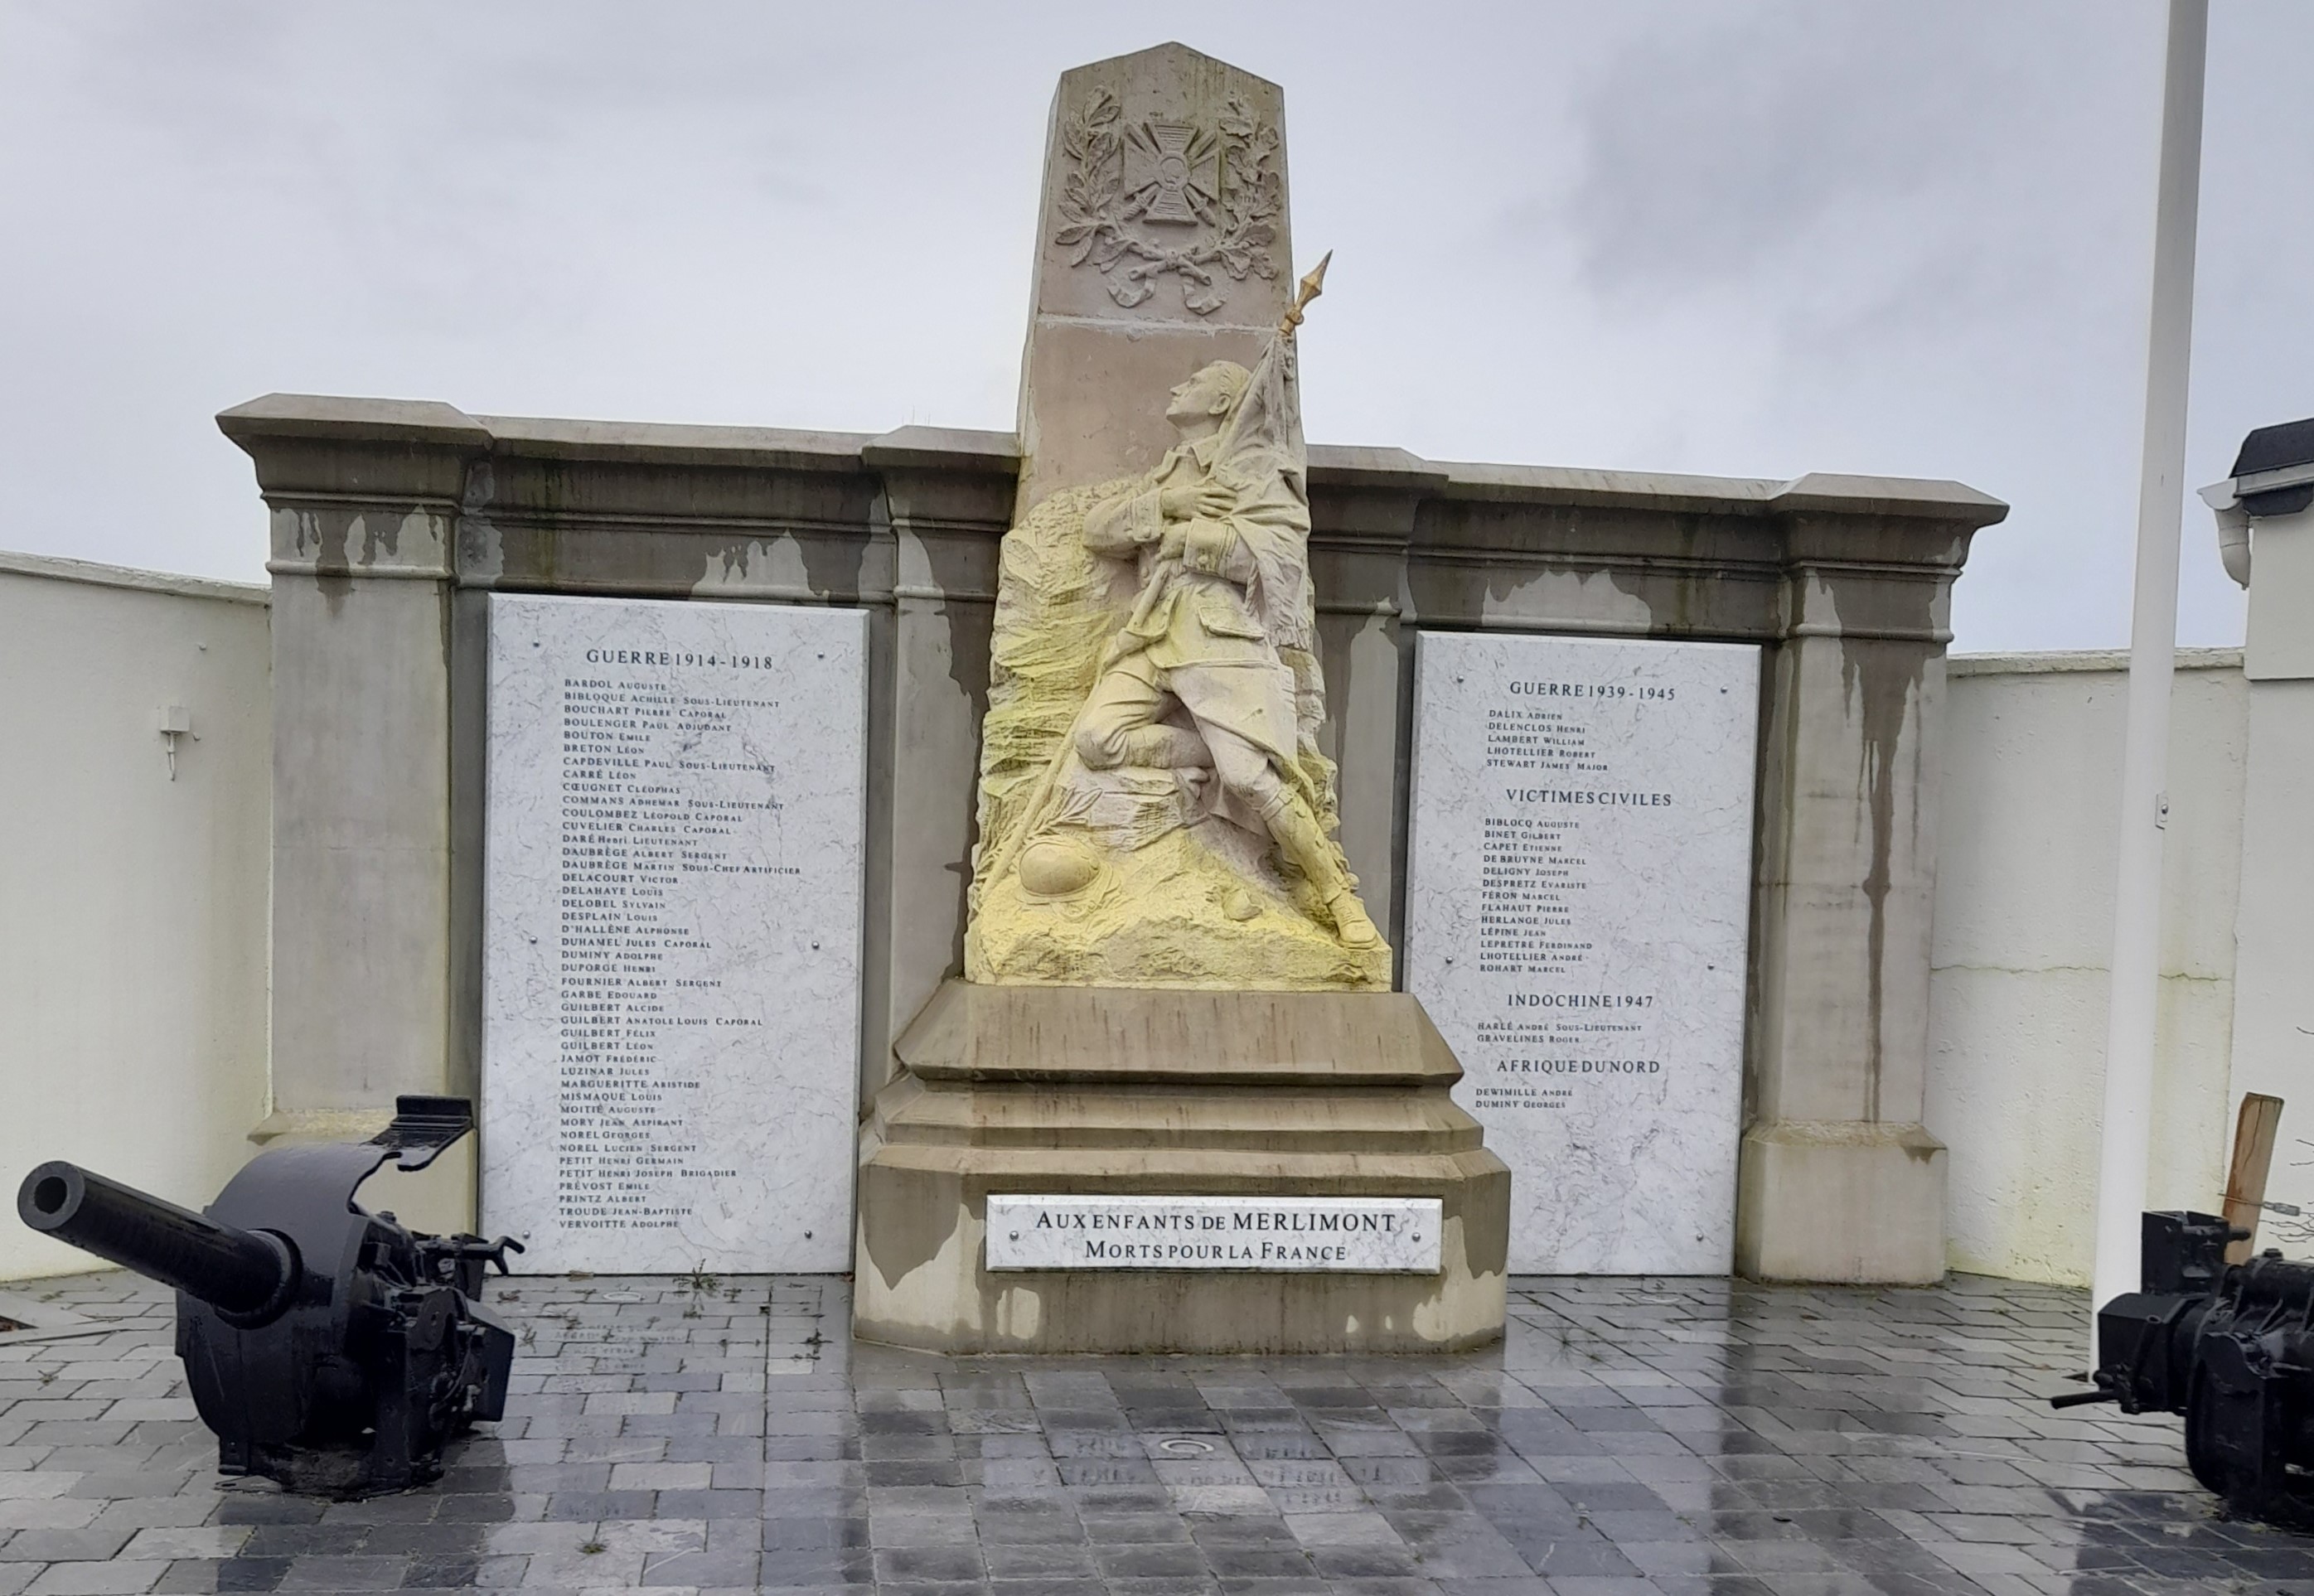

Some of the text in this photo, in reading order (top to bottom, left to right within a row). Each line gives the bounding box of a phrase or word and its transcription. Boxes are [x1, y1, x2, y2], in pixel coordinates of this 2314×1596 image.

[586, 650, 669, 665] GUERRE
[1509, 682, 1584, 696] GUERRE
[1506, 790, 1672, 805] VICTIMES CIVILES
[1508, 994, 1612, 1007] INDOCHINE
[1497, 1060, 1660, 1074] AFRIQUE DU NORD
[1036, 1212, 1396, 1231] AUX ENFANTS DE MERLIMONT
[1086, 1241, 1345, 1260] MORTS POUR LA FRANCE
